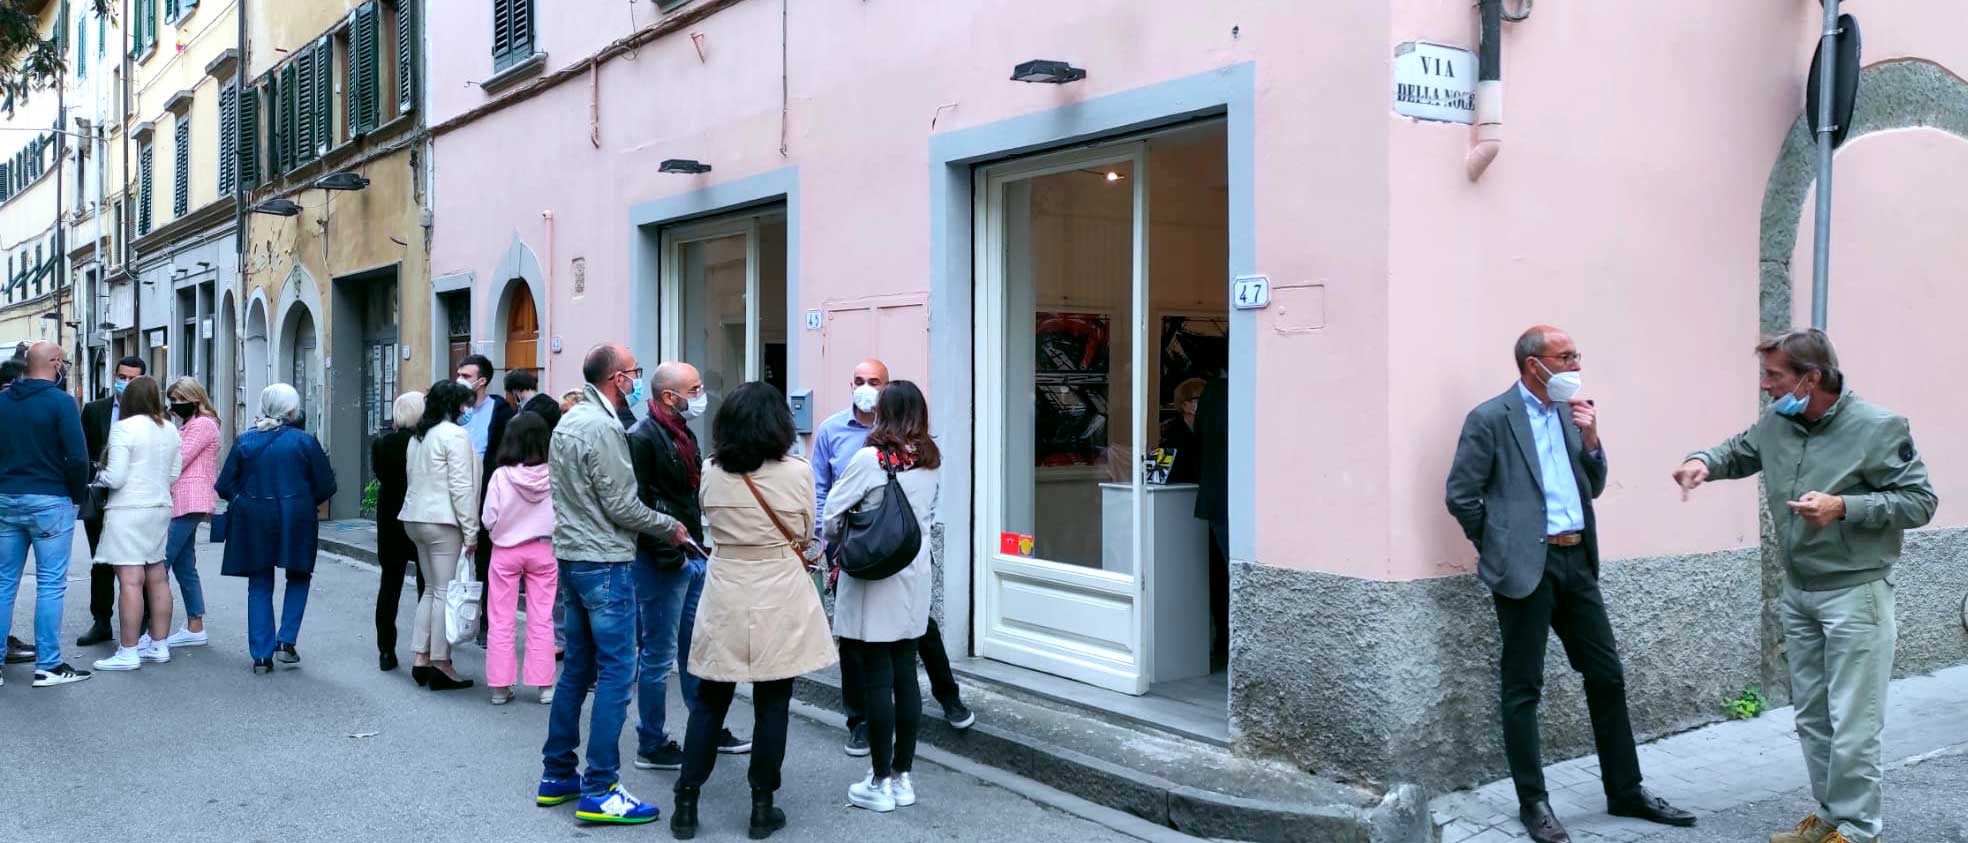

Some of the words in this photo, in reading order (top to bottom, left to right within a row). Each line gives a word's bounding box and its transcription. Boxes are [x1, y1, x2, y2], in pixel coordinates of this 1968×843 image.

[1420, 55, 1456, 78] VIA
[1397, 83, 1441, 106] DELLA
[1239, 284, 1262, 303] 47
